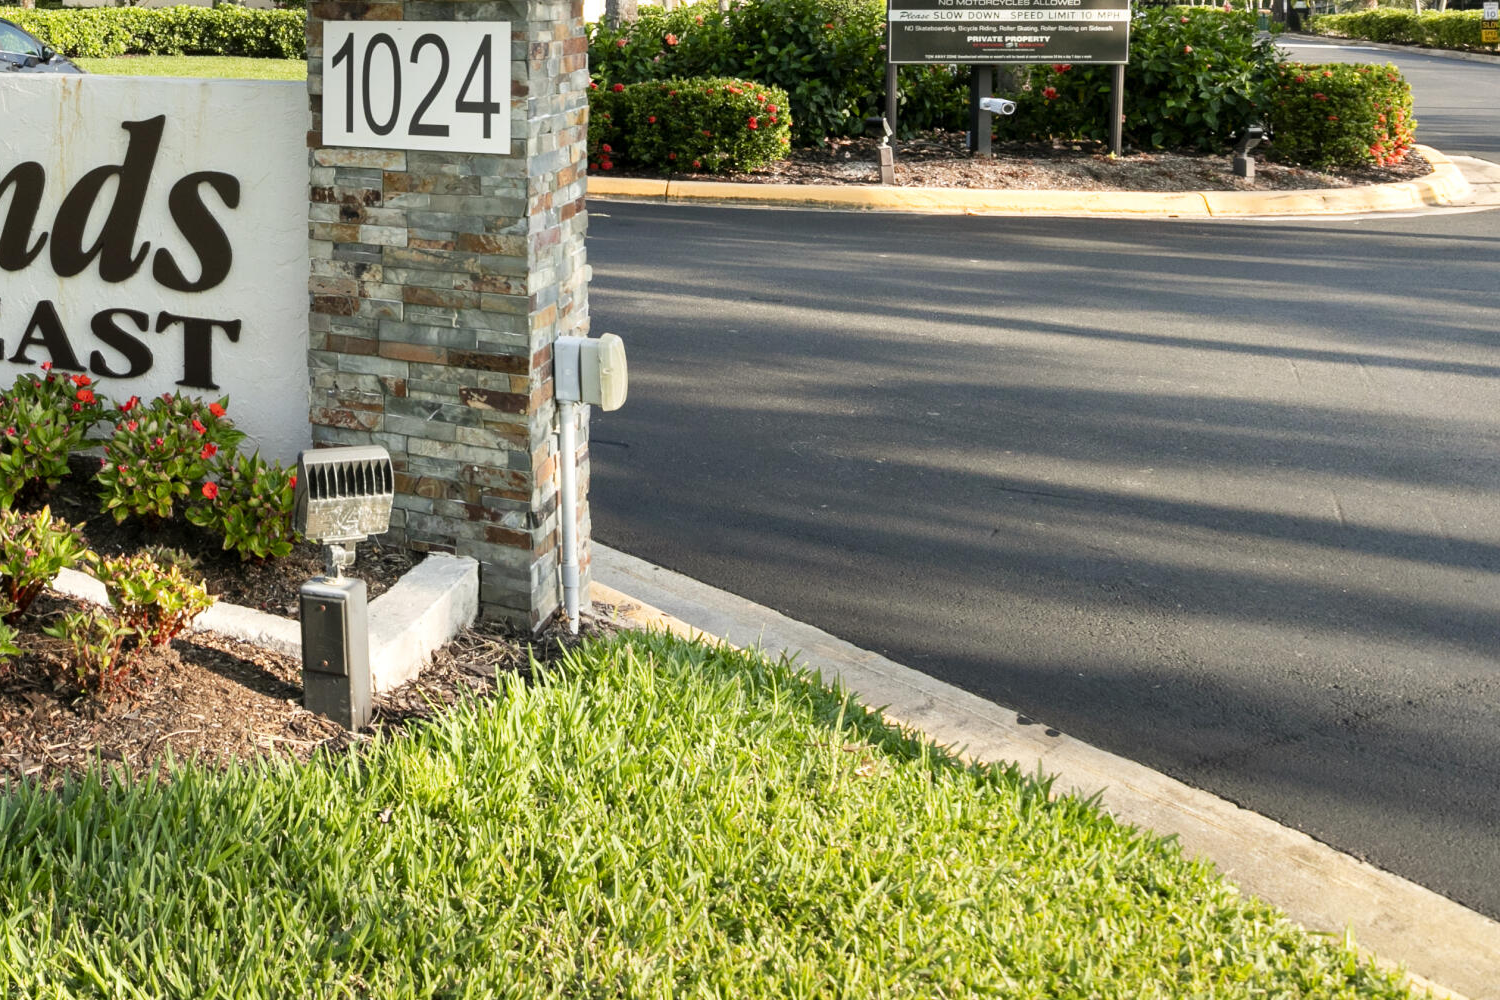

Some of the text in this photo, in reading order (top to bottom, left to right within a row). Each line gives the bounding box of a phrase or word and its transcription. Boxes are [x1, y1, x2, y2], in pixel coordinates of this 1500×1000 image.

[900, 11, 930, 20] Please
[933, 11, 963, 20] SLOW
[1010, 11, 1044, 20] SPEED
[1048, 11, 1076, 20] LIMIT
[1081, 11, 1092, 20] 10
[1098, 11, 1121, 20] MPH
[331, 32, 501, 139] 1024
